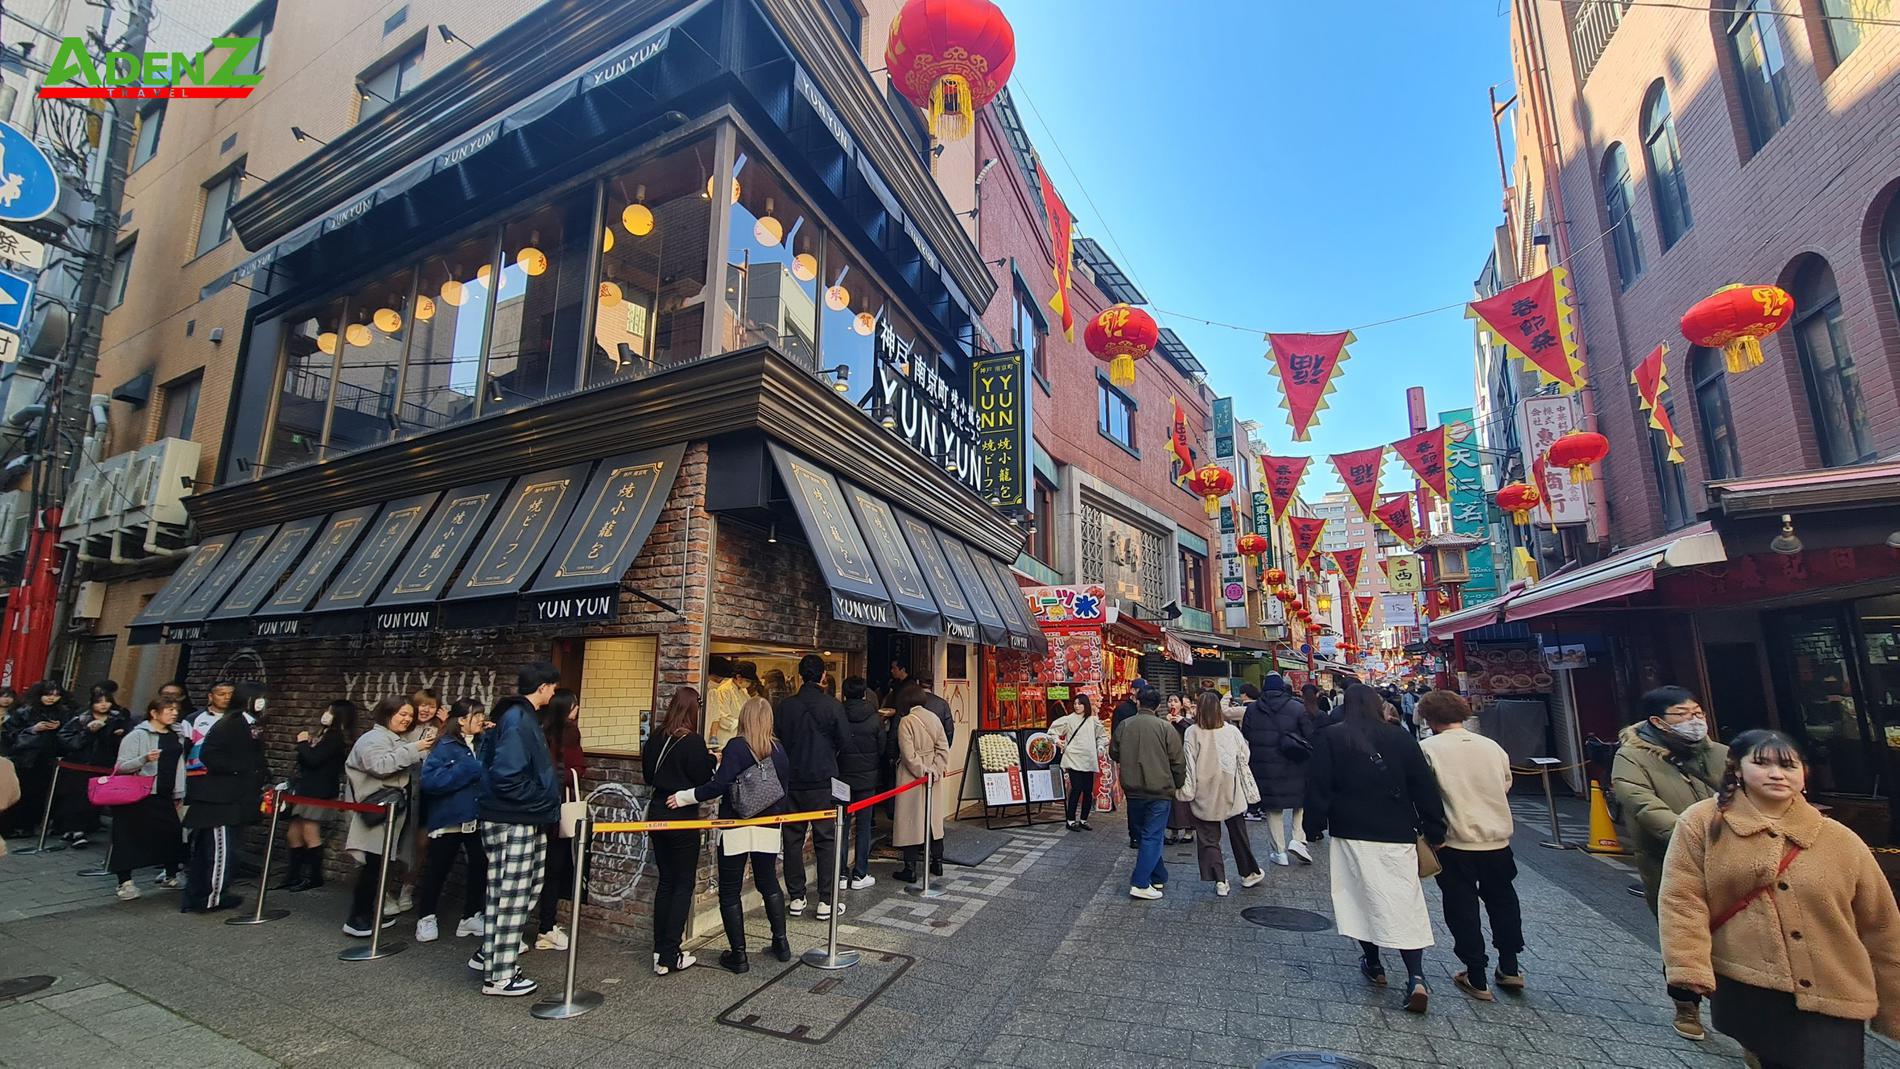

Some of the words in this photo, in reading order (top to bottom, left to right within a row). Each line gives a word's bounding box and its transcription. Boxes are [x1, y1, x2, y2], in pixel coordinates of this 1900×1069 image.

[594, 61, 627, 85] YUN
[629, 40, 662, 67] YUN
[1511, 296, 1559, 355] 春節祭
[880, 317, 911, 363] 神戸
[913, 353, 950, 412] 南京町
[1289, 353, 1327, 386] 福
[981, 439, 996, 500] 焼ビーフン
[998, 437, 1013, 499] 焼小籠包
[1274, 464, 1293, 498] 春節祭
[1350, 463, 1374, 486] 福
[1415, 440, 1443, 478] 春節祭
[1449, 450, 1482, 524] 天仁茗
[495, 498, 545, 570] 焼ビーフン
[587, 482, 635, 560] 焼小籠包
[418, 511, 466, 578] 焼小籠包
[1395, 568, 1412, 581] 西
[258, 621, 277, 635] YUN
[279, 619, 298, 634] YUN
[377, 613, 400, 629] YUN
[402, 611, 430, 627] YUN
[537, 600, 571, 619] YUN
[575, 596, 611, 617] YUN
